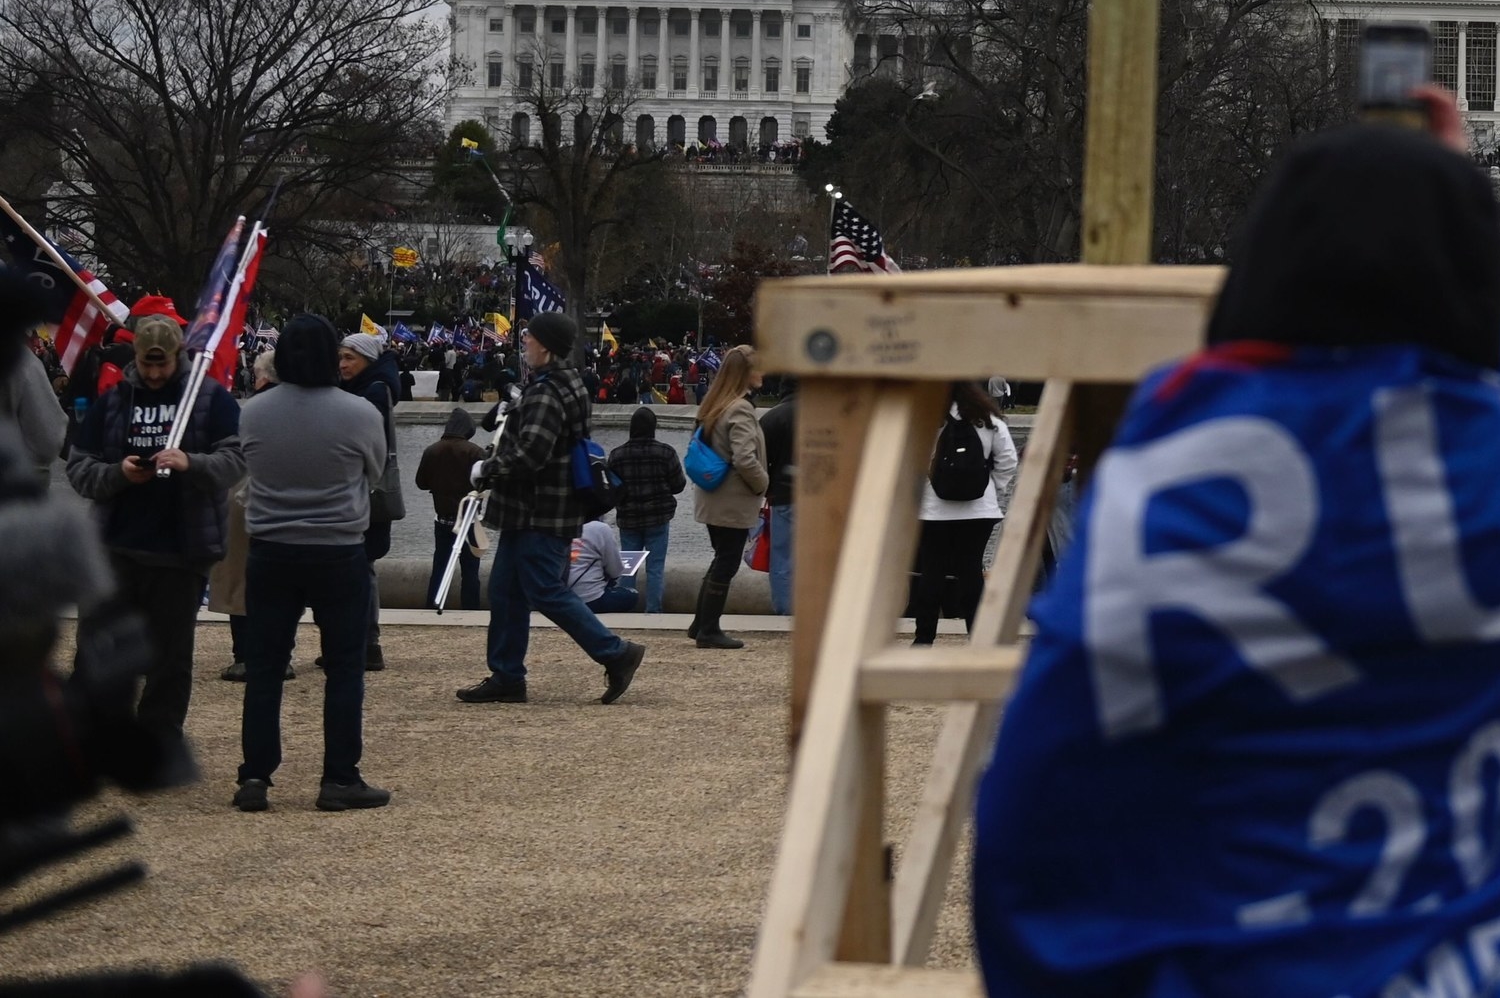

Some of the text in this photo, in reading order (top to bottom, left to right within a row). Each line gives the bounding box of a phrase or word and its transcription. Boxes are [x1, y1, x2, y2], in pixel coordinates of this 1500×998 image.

[132, 404, 176, 424] RUM
[140, 425, 163, 434] 2020
[132, 435, 168, 447] YOUR FEE
